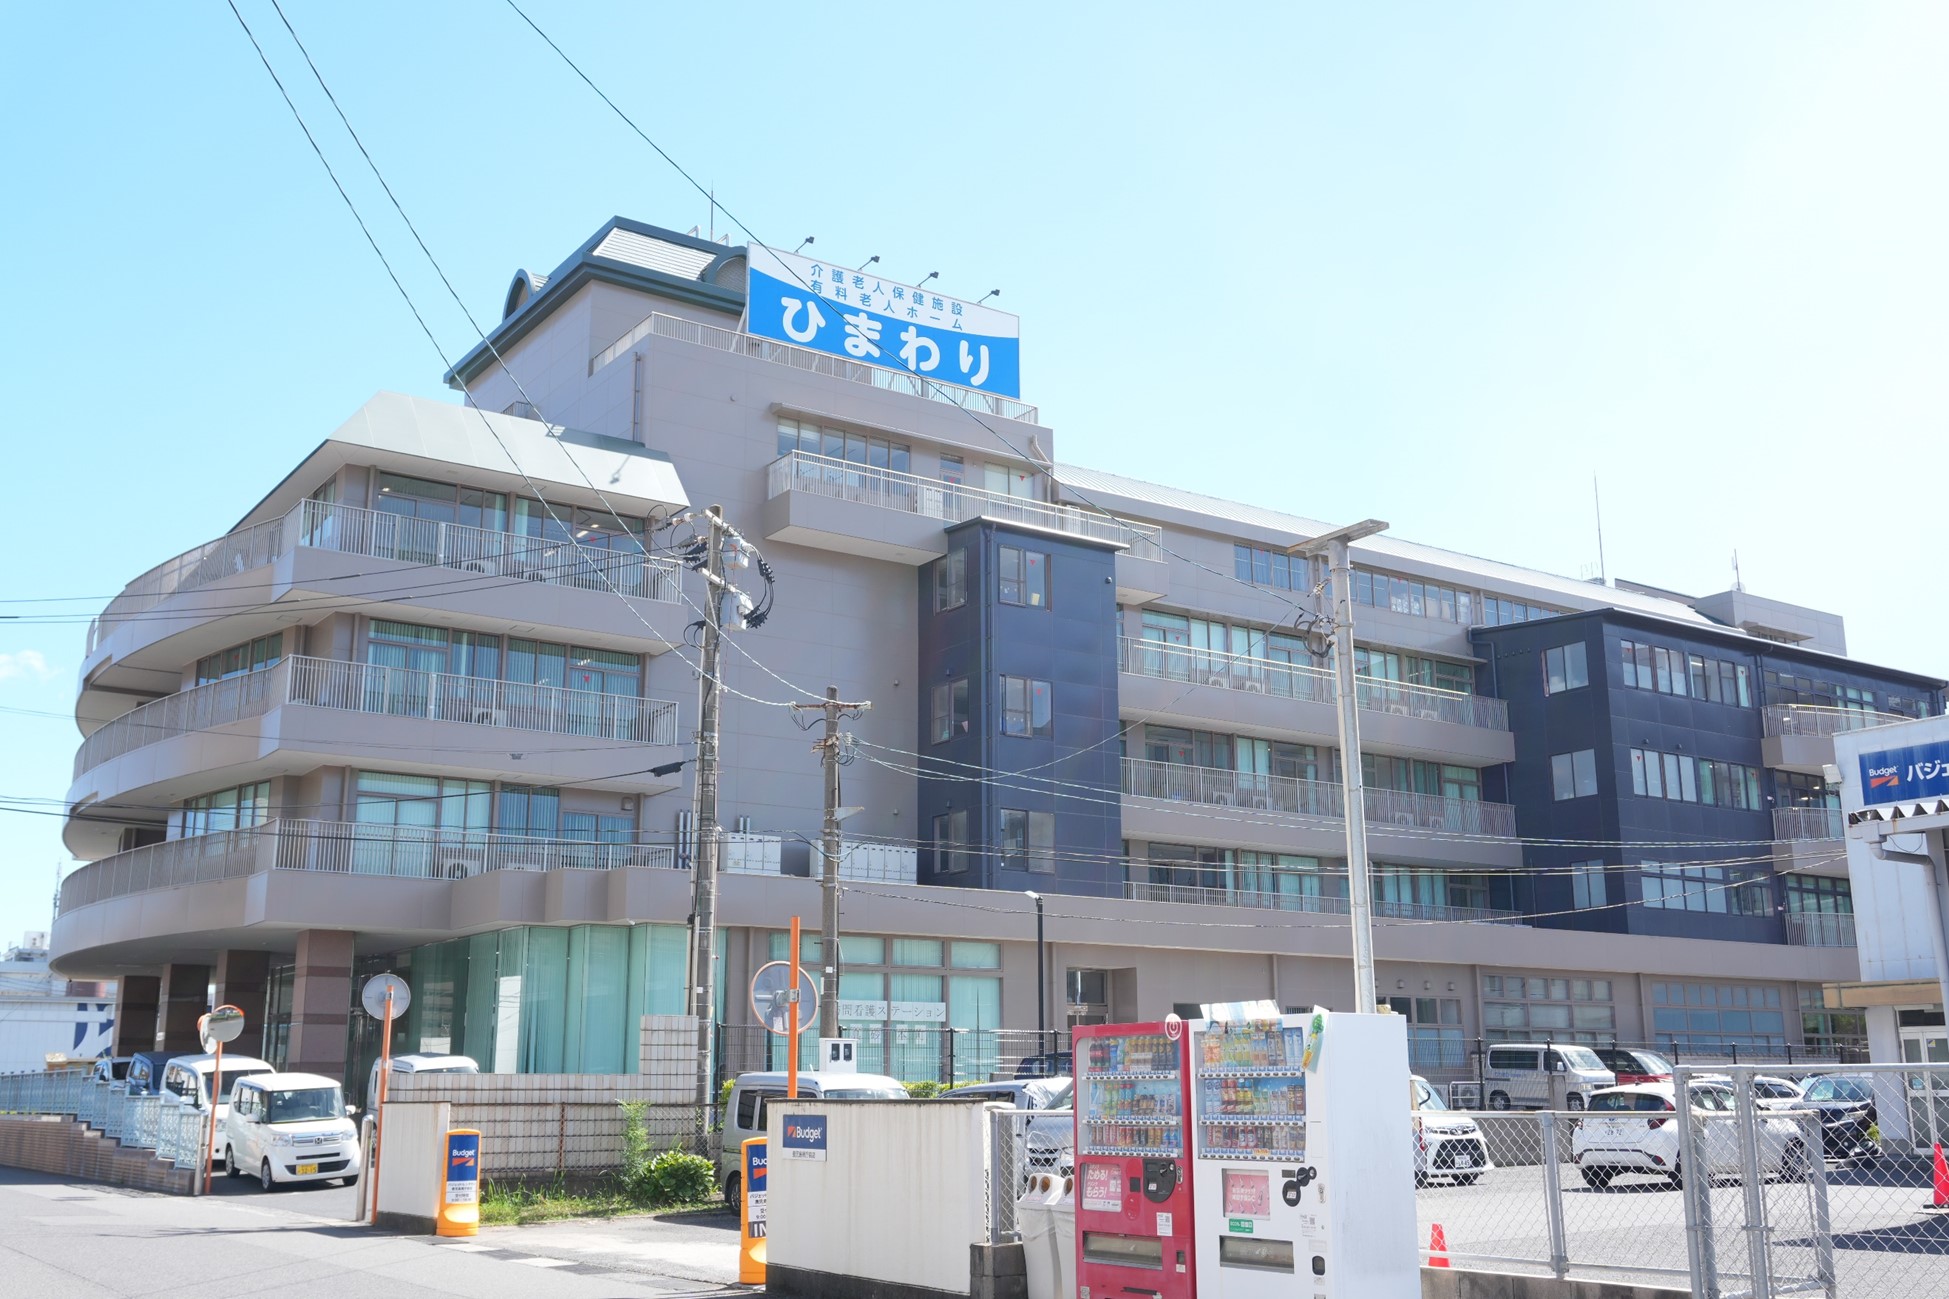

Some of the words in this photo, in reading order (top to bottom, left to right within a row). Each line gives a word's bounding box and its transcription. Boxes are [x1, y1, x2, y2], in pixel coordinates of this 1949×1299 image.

[810, 263, 963, 317] 介護老人保健施設
[810, 279, 963, 331] 有料老人ホーム
[781, 296, 990, 387] ひまわり
[1869, 765, 1898, 777] Budget
[796, 1126, 822, 1143] Budget
[452, 1149, 475, 1158] Budget
[1086, 1186, 1107, 1198] もらう!
